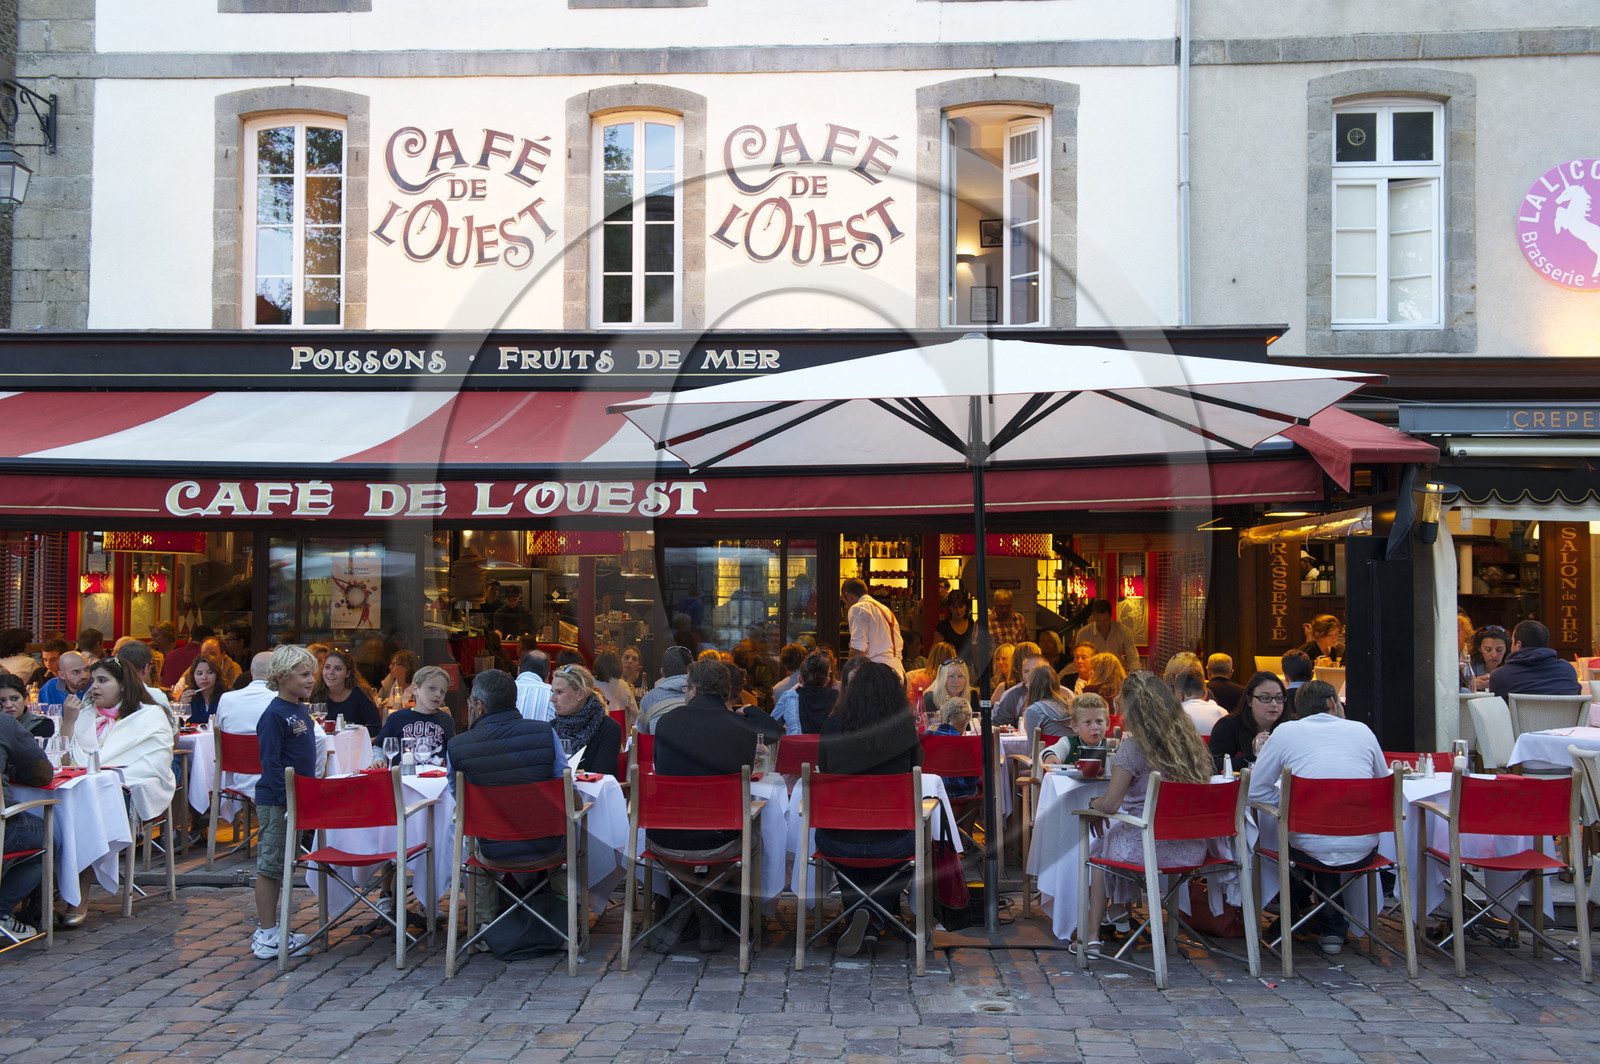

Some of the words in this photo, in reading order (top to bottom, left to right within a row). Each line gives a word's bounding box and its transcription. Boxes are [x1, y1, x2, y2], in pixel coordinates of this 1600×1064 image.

[385, 126, 553, 195] CAFÉ
[723, 123, 901, 196] CAFÉ
[448, 178, 488, 201] DE
[789, 175, 829, 198] DE
[369, 197, 558, 271] L'OUEST
[709, 195, 905, 270] L'OUEST
[1521, 231, 1585, 287] Brasserie
[290, 346, 448, 374] POISSONS
[498, 346, 615, 374] FRUITS
[637, 348, 682, 371] DE
[702, 348, 781, 372] MER
[1512, 410, 1600, 428] CREPE
[164, 480, 334, 517] CAFÉ
[364, 481, 448, 517] DE
[472, 480, 707, 517] L'OUEST
[1560, 527, 1578, 589] SALON
[1270, 542, 1288, 641] RASSERIE
[1562, 591, 1576, 601] de
[1562, 605, 1578, 643] THE
[403, 720, 445, 744] ROCK
